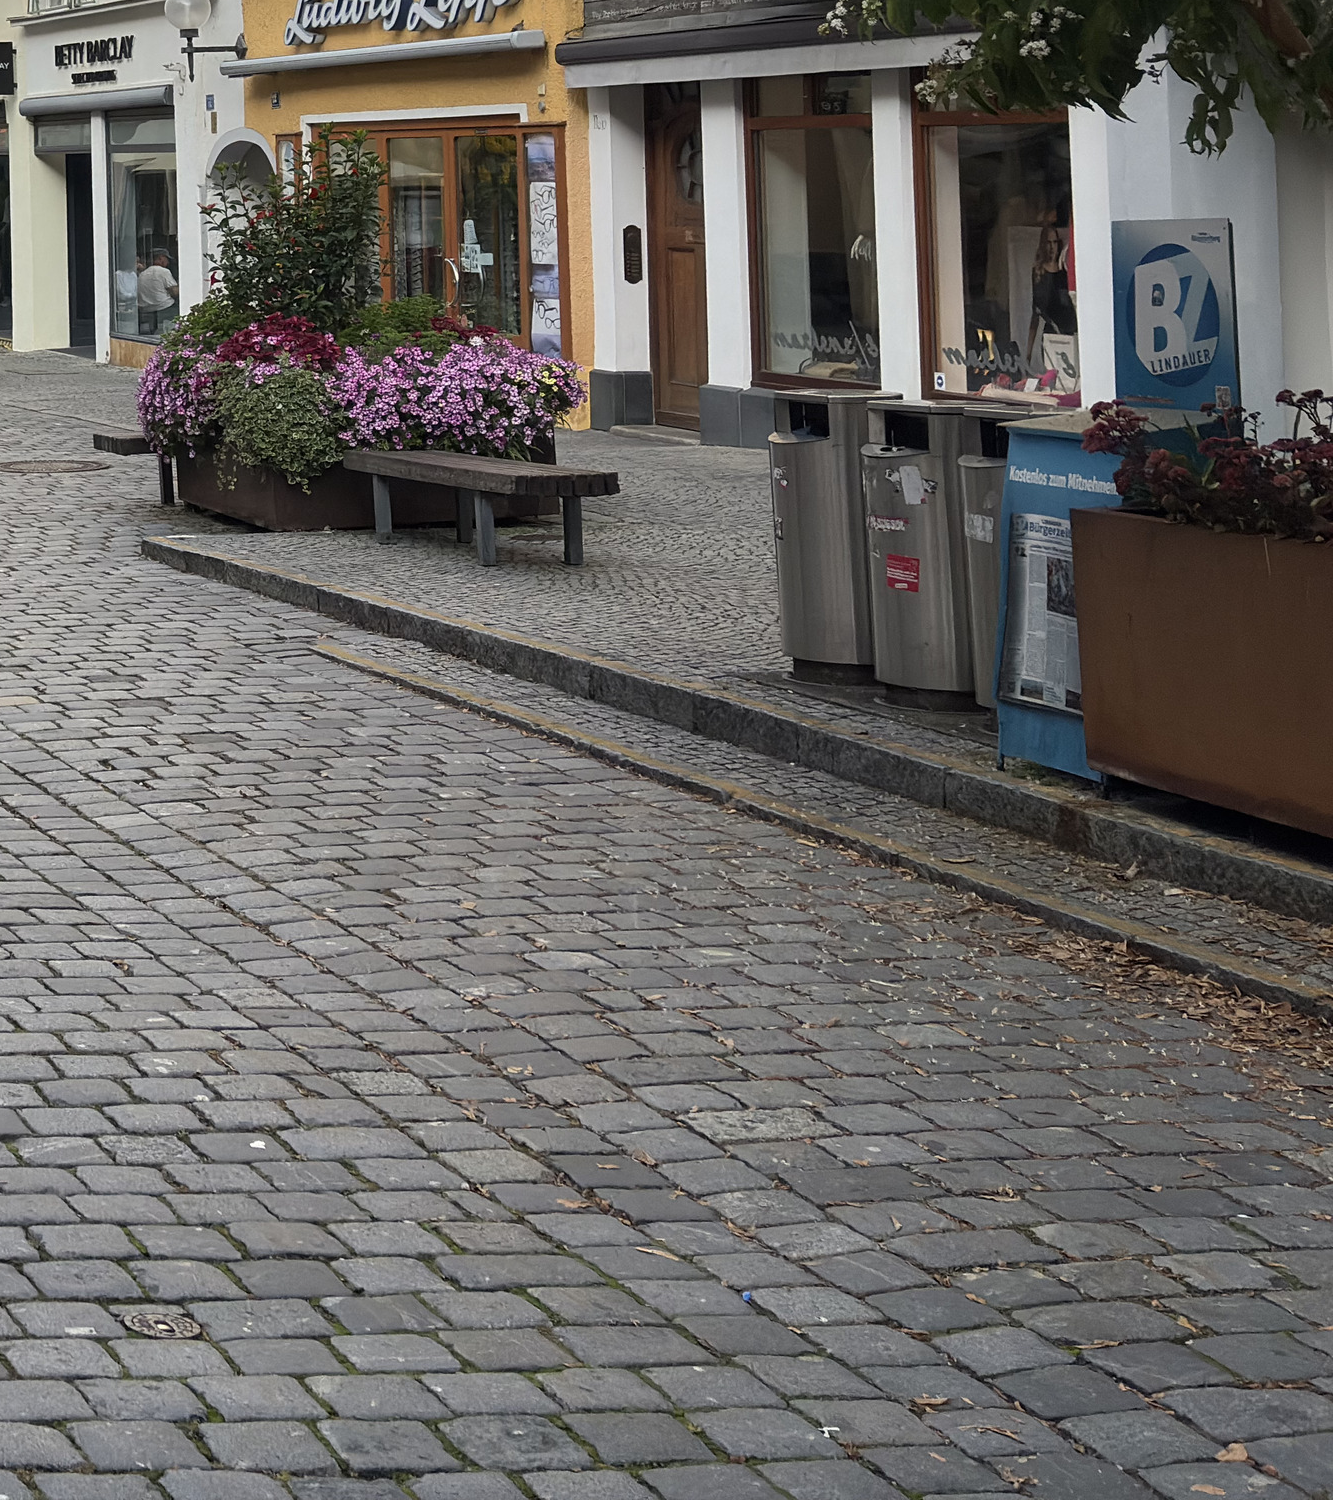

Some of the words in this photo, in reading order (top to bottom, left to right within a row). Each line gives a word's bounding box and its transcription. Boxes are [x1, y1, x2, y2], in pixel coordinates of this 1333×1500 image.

[54, 41, 85, 68] BETTY
[86, 35, 134, 64] BARCLAY
[1150, 348, 1211, 374] LINDAUER
[1009, 465, 1048, 486] Kostenlos
[1048, 474, 1067, 488] zum
